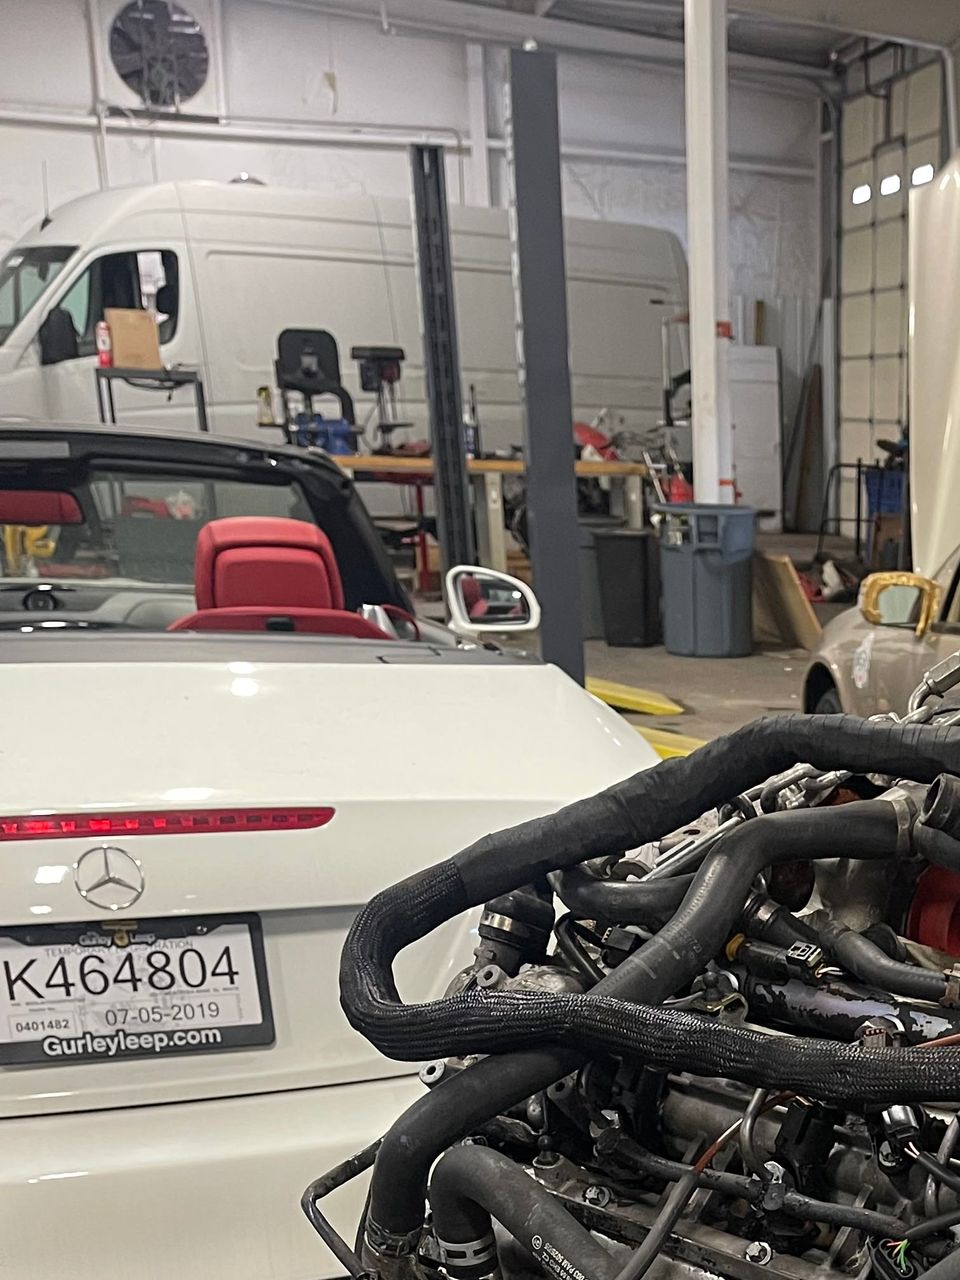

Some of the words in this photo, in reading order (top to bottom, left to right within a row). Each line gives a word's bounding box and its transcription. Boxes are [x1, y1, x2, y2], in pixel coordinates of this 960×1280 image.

[3, 946, 239, 1000] K464804
[15, 1019, 69, 1032] 0401482
[105, 1002, 220, 1026] 07-05-2019
[43, 1028, 221, 1056] Gurleyleep.com
